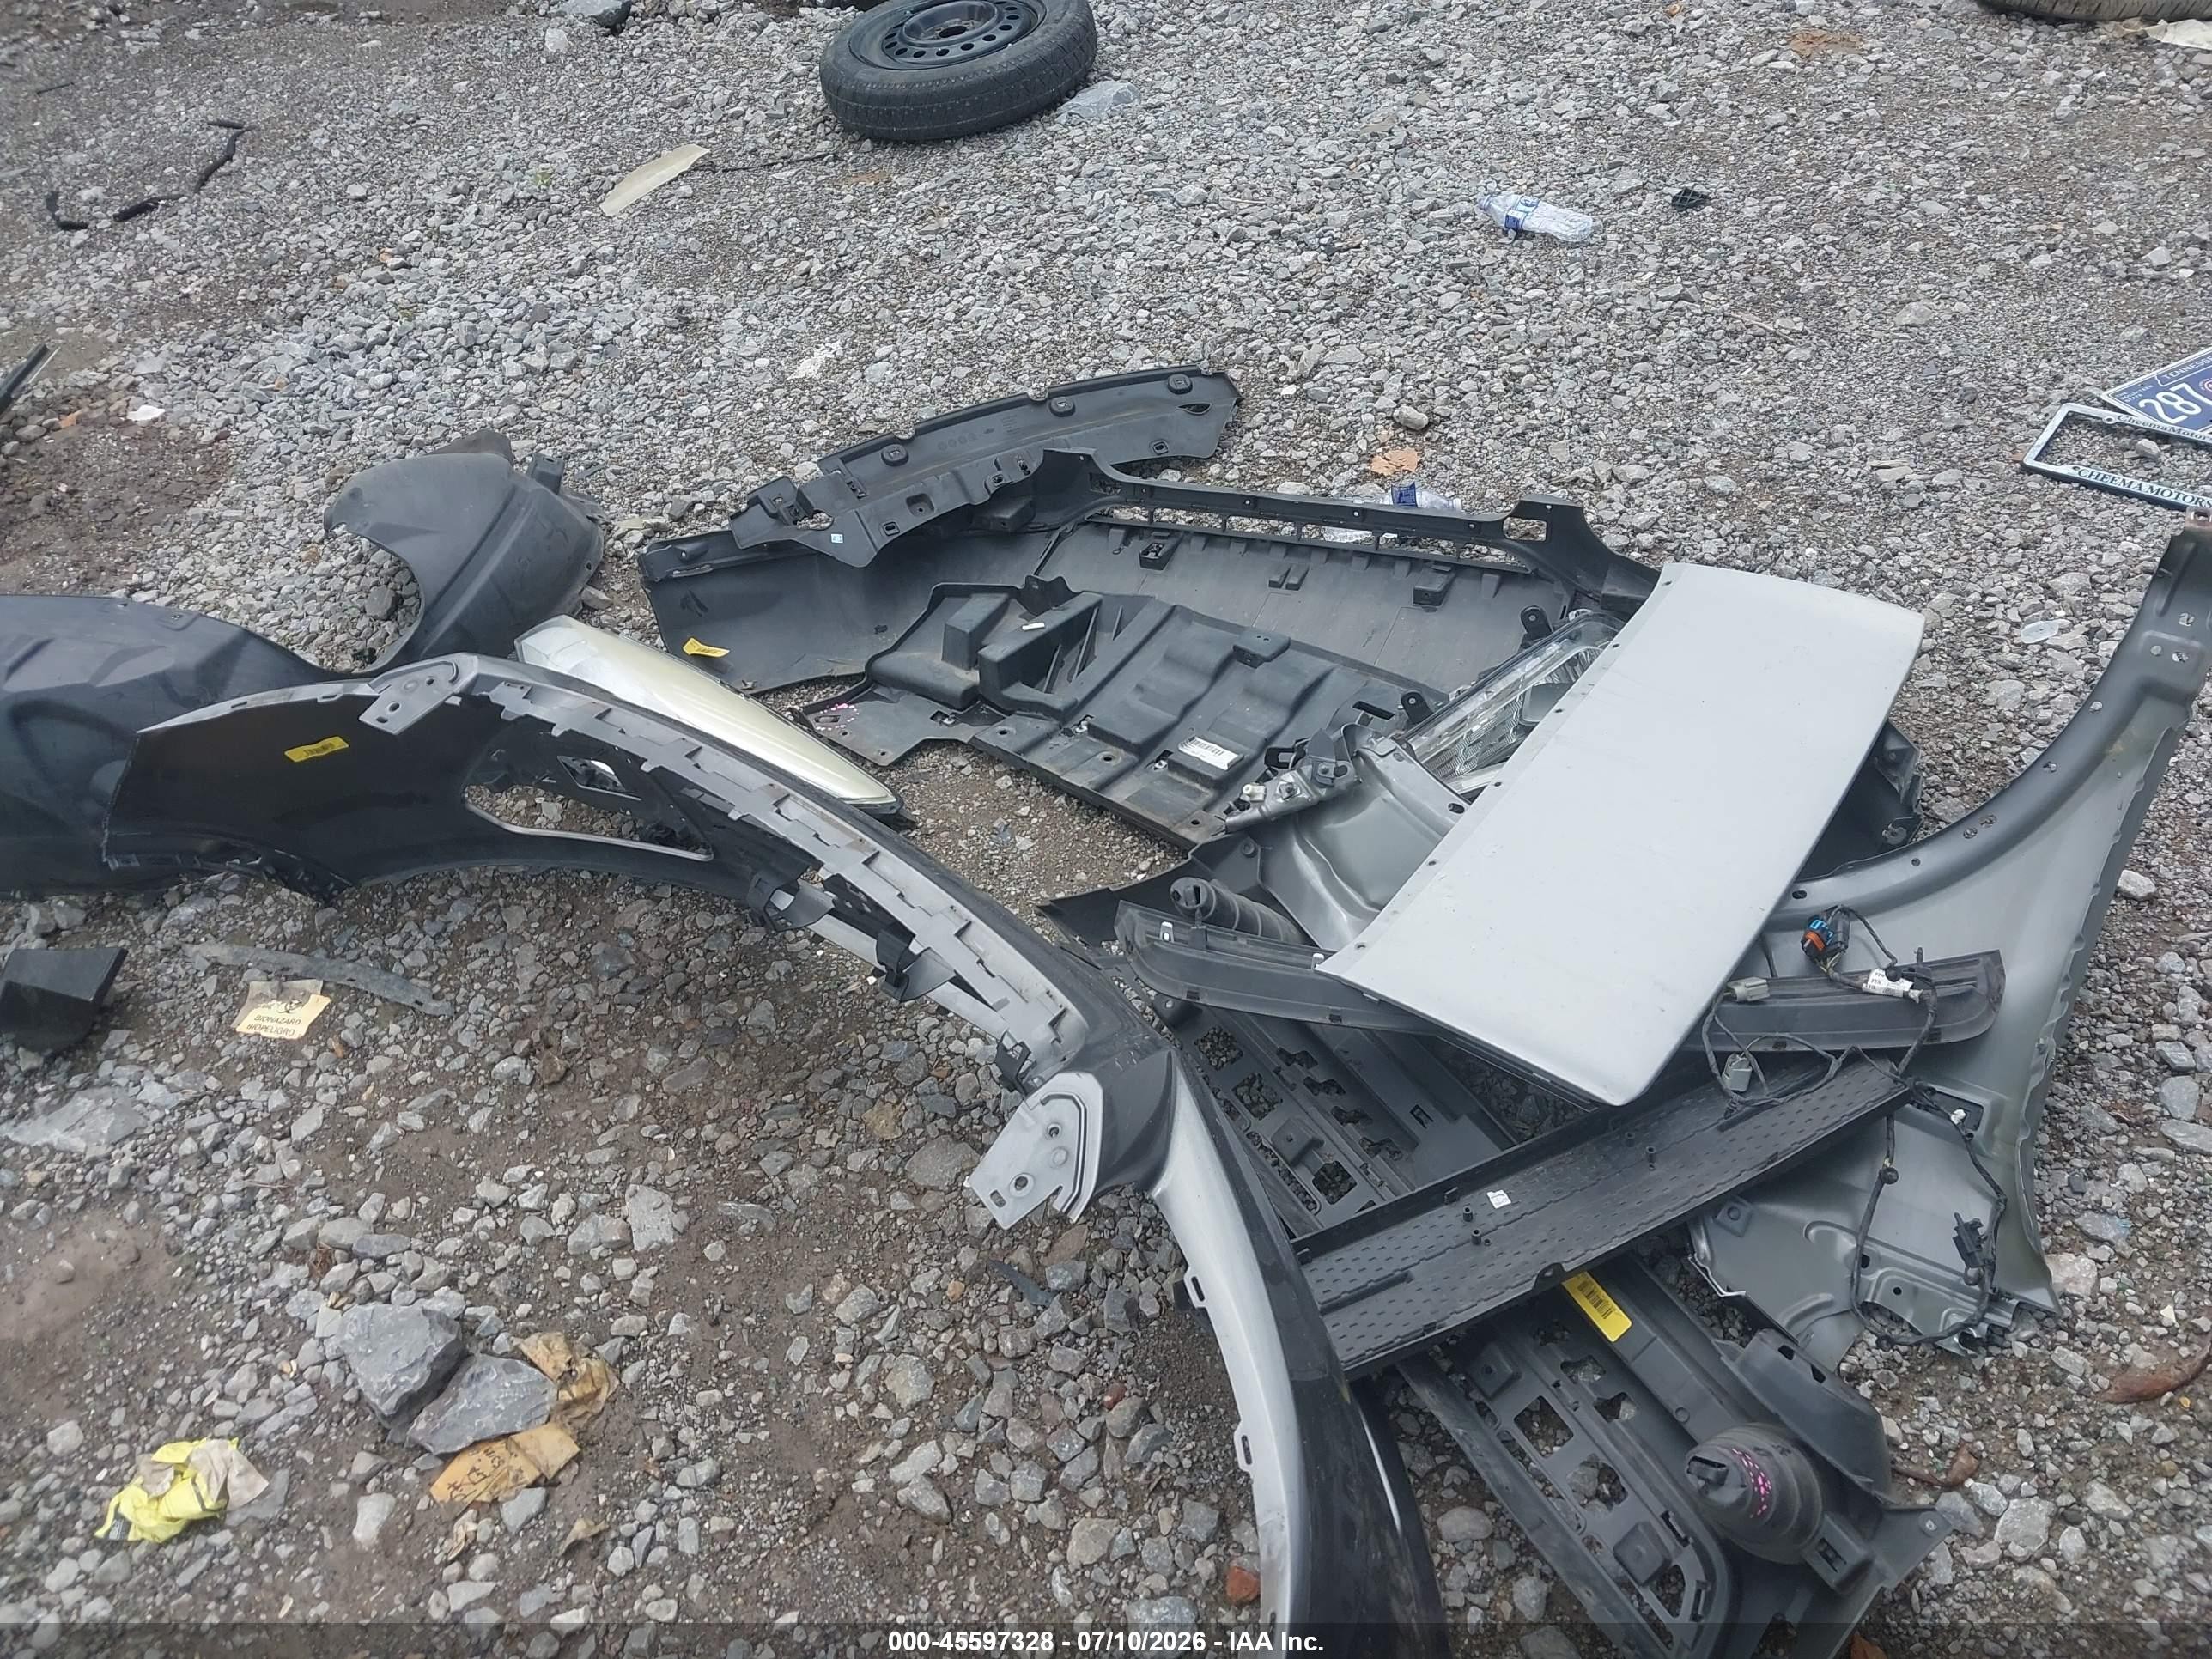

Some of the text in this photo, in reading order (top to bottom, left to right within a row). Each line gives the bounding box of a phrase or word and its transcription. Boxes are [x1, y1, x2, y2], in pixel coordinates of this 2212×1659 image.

[2078, 468, 2143, 491] CHEEMA
[254, 1014, 301, 1025] BIOHAZARD
[246, 1023, 295, 1036] BIOPELIGRO
